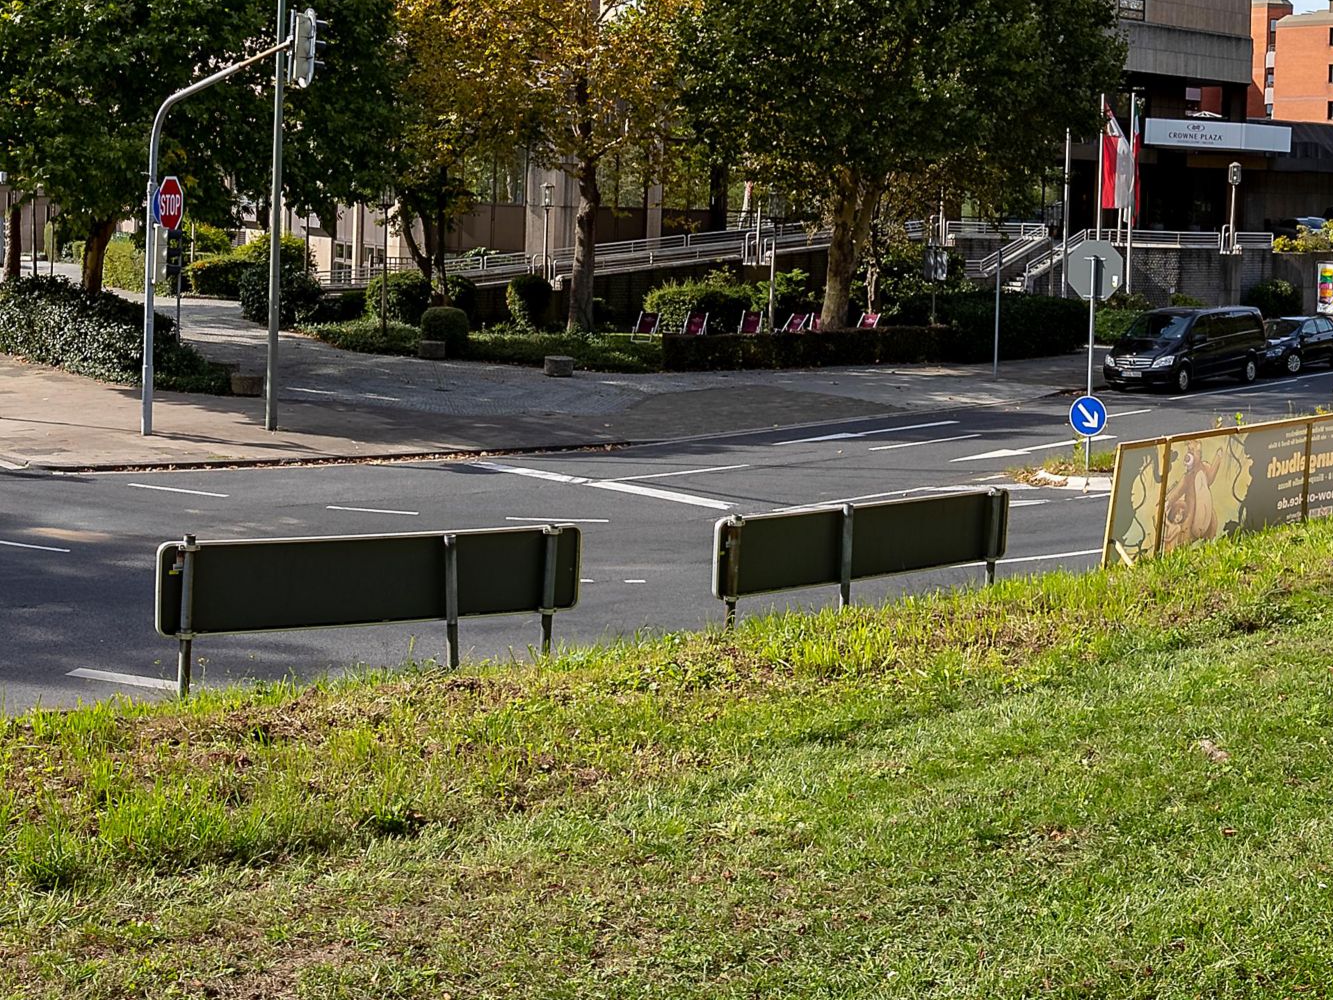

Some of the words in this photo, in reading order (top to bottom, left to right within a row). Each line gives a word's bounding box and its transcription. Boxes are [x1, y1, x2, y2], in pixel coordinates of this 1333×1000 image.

[1168, 131, 1198, 140] CROWNE
[1200, 134, 1222, 142] PLAZA
[160, 193, 180, 216] STOP
